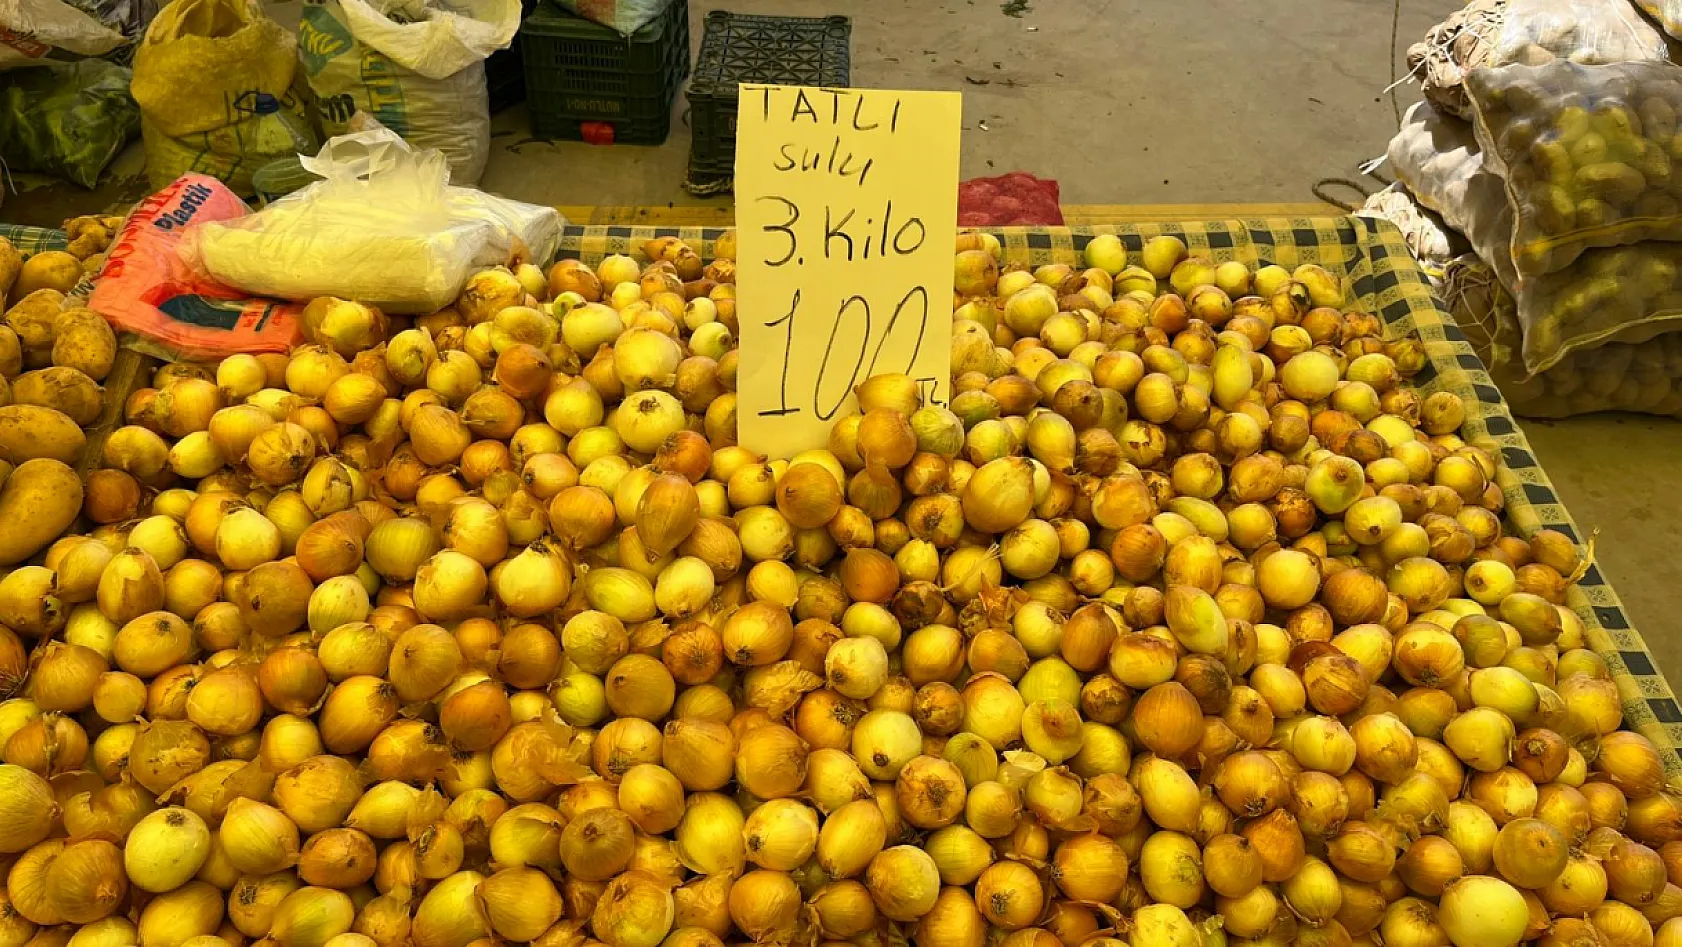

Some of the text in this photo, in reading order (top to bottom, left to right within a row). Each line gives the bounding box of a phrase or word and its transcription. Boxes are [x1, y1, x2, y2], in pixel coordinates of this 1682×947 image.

[744, 86, 900, 133] TATLI
[153, 182, 213, 230] Plastik
[758, 285, 928, 421] 100
